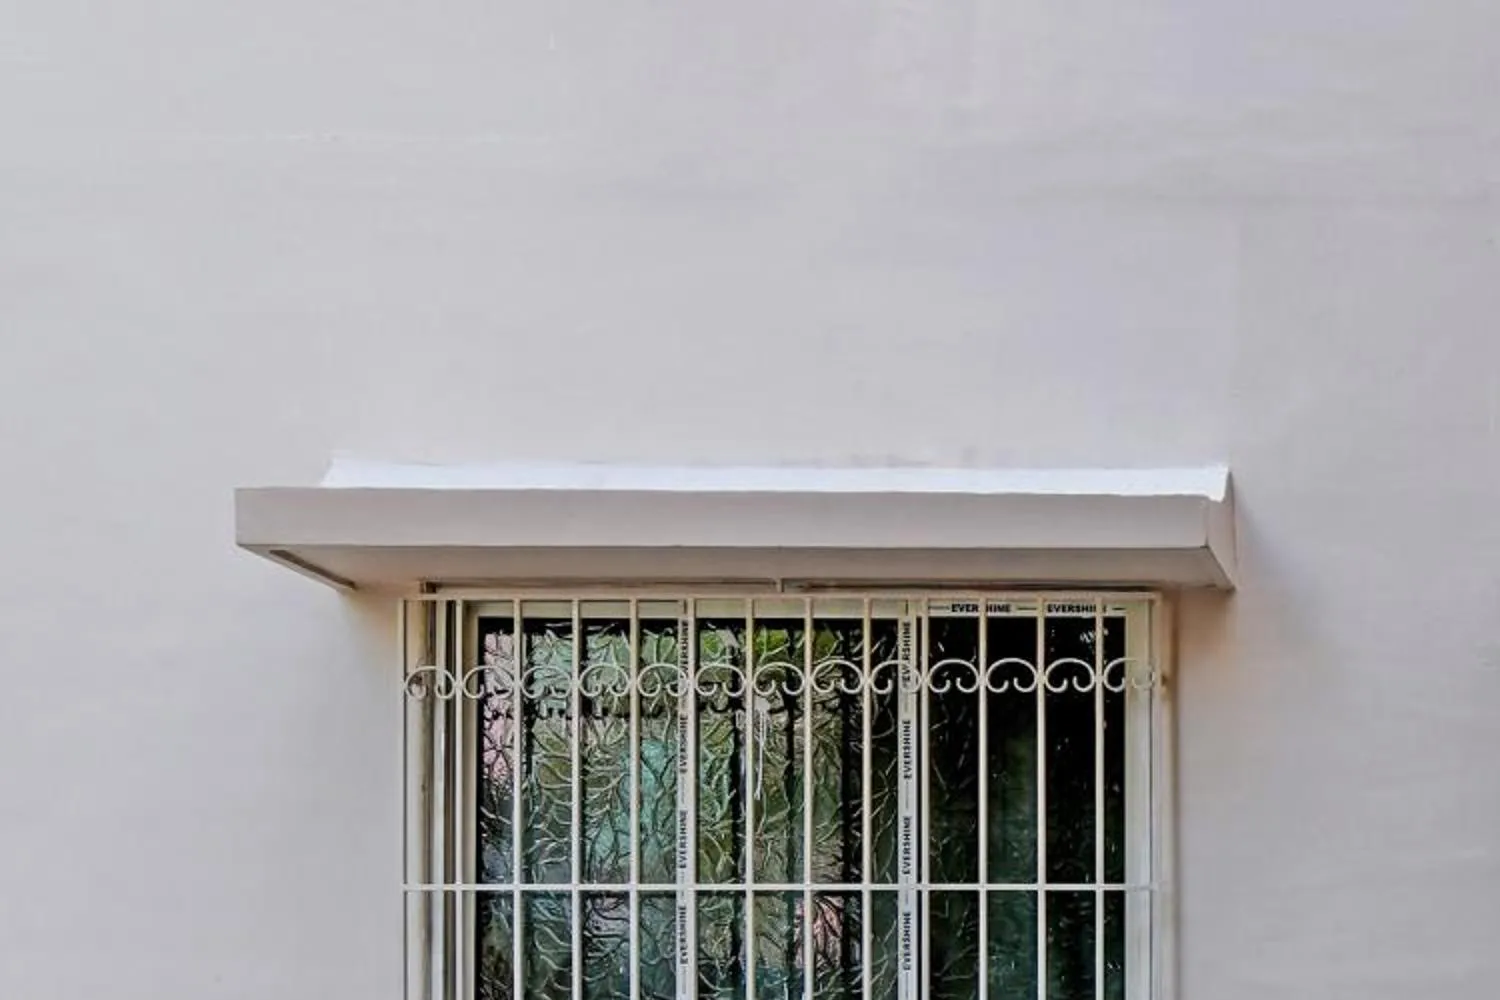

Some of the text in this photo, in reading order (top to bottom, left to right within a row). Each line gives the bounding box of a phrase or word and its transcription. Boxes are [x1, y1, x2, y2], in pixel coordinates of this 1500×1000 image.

[951, 603, 1011, 613] EVERHINE
[679, 713, 688, 774] EVERSHINE
[902, 720, 912, 779] EVERSHINE
[679, 810, 688, 869] EVERSHINE
[902, 816, 911, 875] EVERSHINE
[679, 906, 688, 965] EVERSHINE
[903, 912, 911, 971] EVERSHINE
